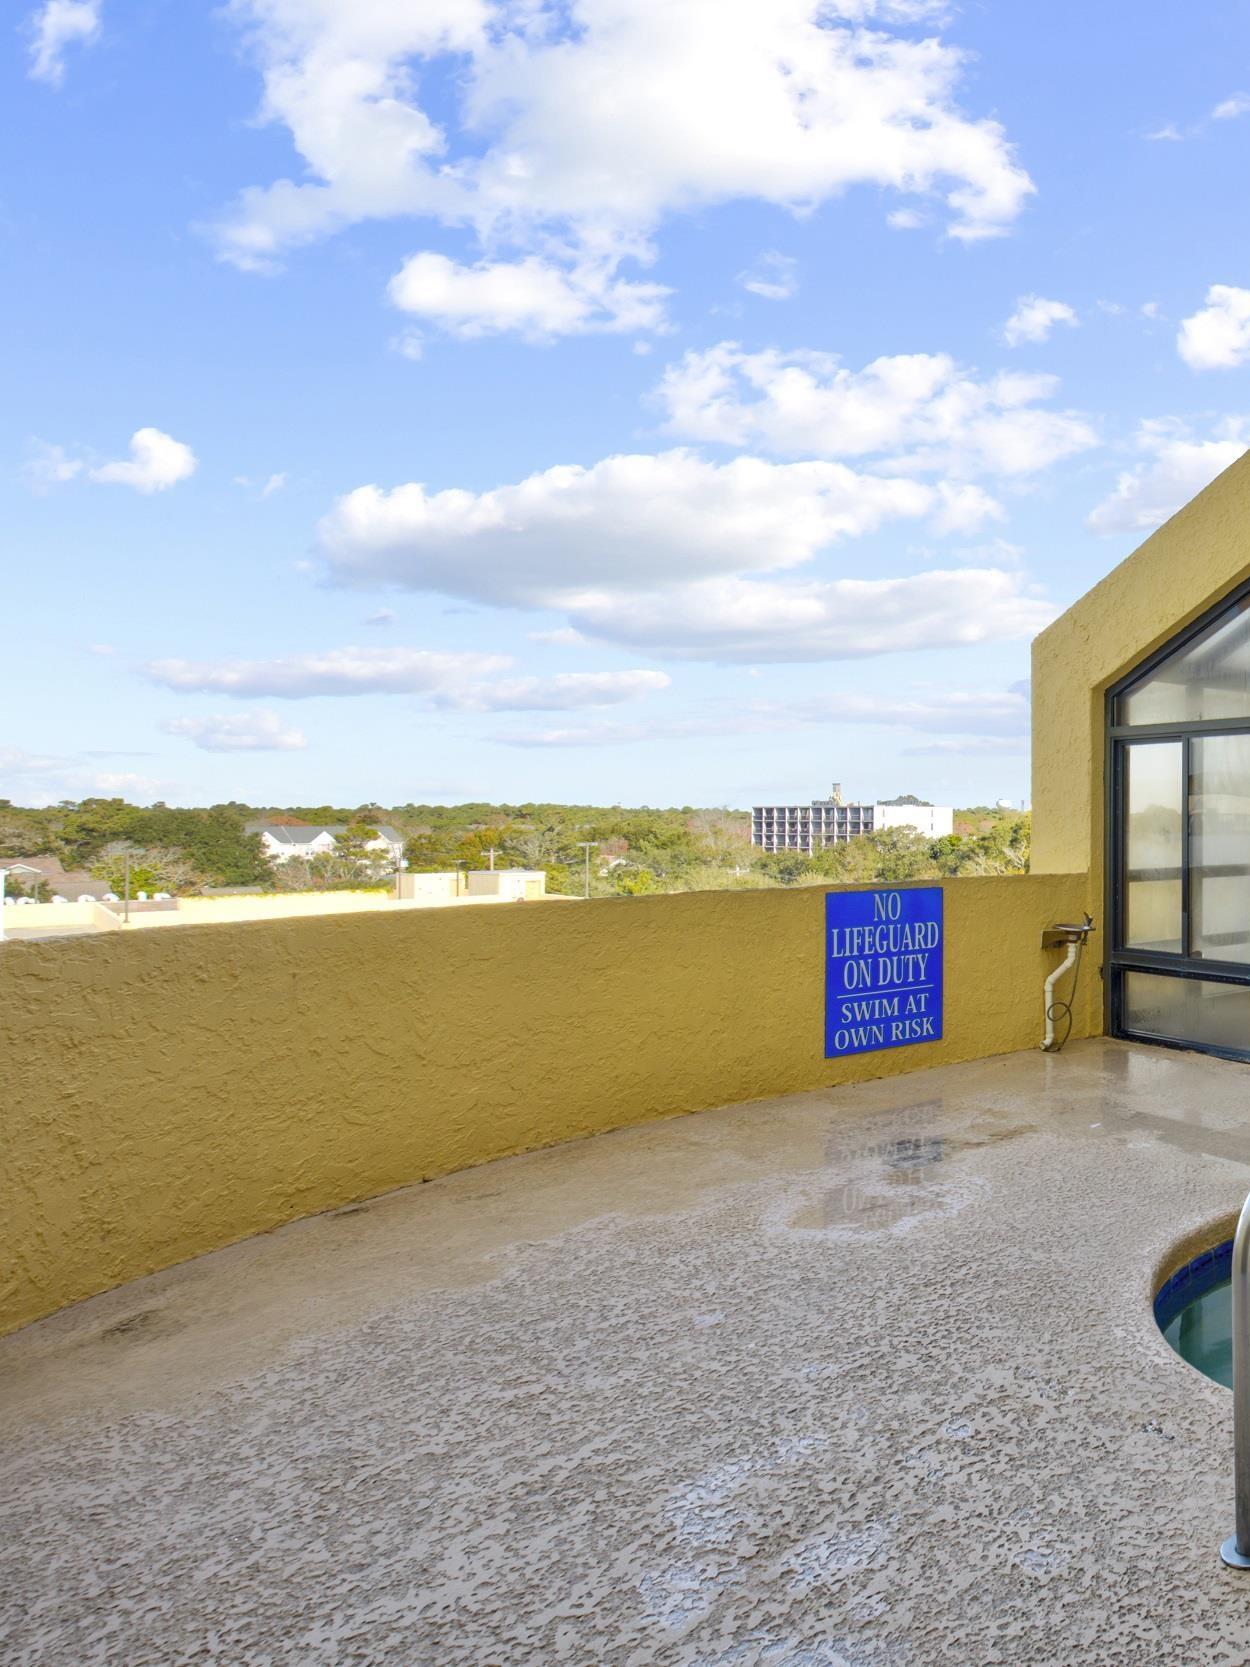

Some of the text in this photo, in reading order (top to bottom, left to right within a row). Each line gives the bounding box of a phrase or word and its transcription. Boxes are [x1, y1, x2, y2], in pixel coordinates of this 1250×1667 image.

[873, 892, 901, 922] NO
[831, 921, 939, 958] LIFEGUARD
[843, 953, 929, 990] ON DUTY
[841, 993, 929, 1024] SWIM AT
[834, 1016, 935, 1050] OWN RISK
